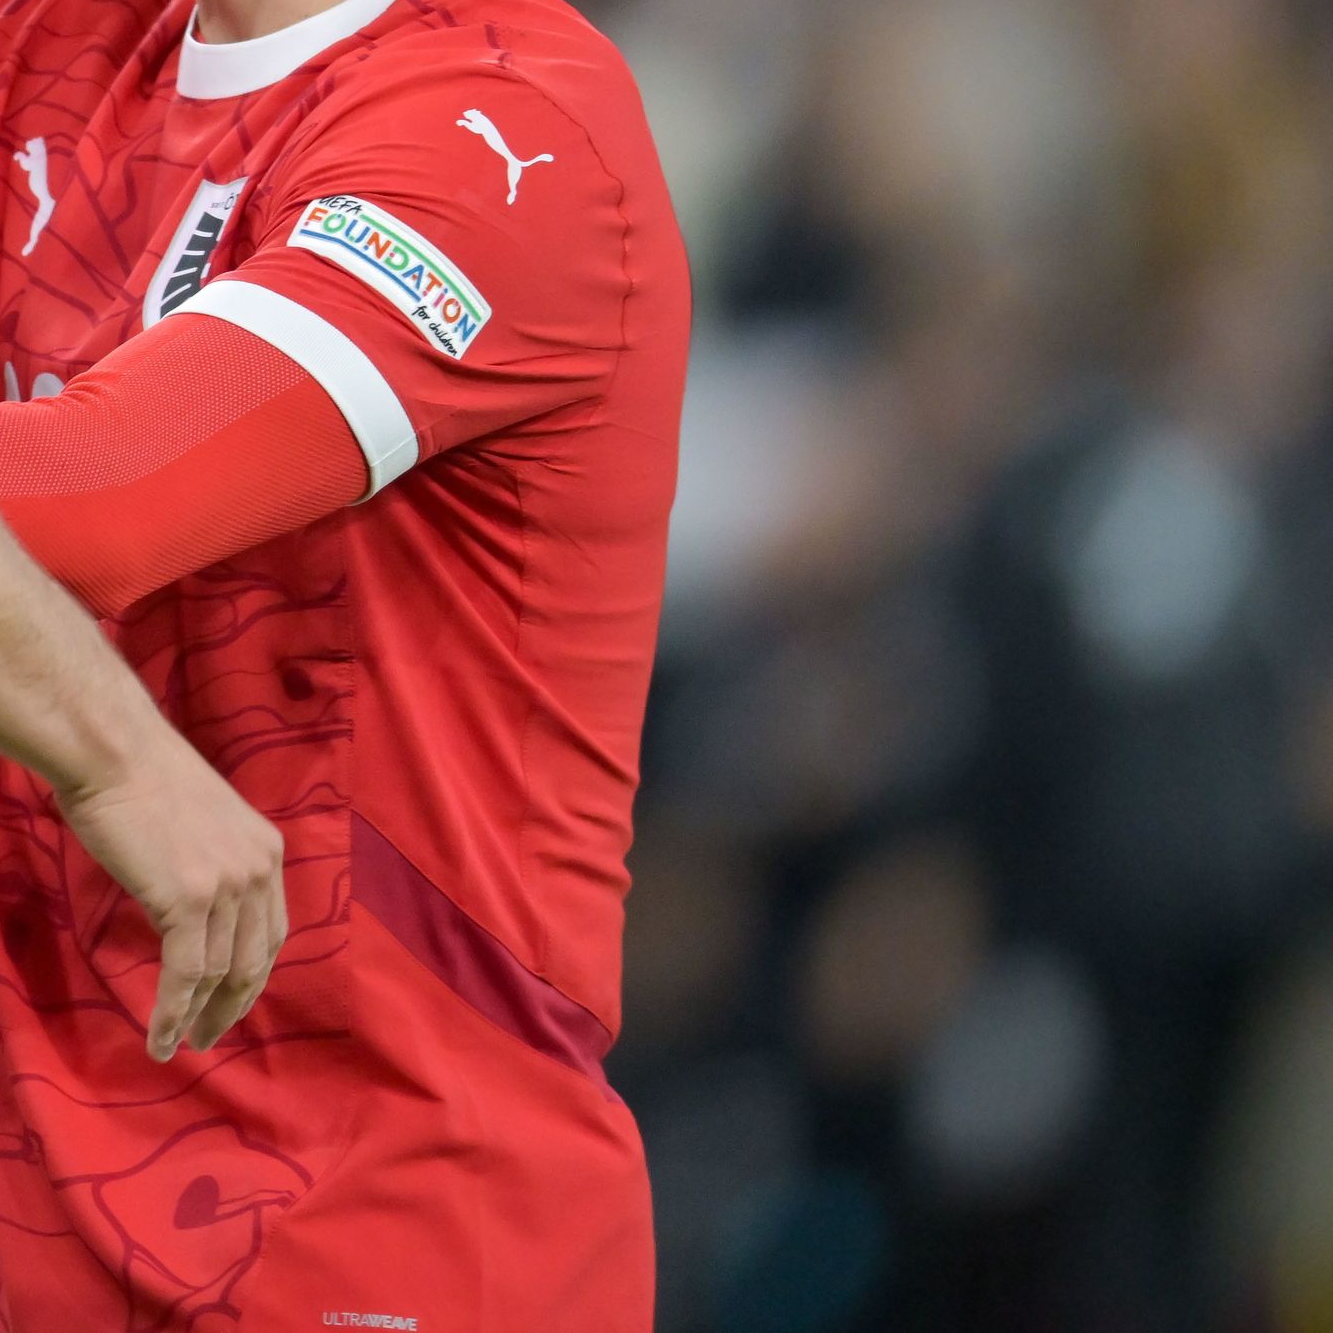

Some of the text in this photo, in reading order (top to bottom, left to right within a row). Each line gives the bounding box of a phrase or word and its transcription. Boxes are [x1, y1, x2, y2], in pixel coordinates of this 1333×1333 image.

[318, 195, 363, 215] UEFA
[304, 207, 477, 343] FOUNDATION
[411, 305, 458, 357] for children
[322, 1311, 418, 1332] ULTRAWEAVE
